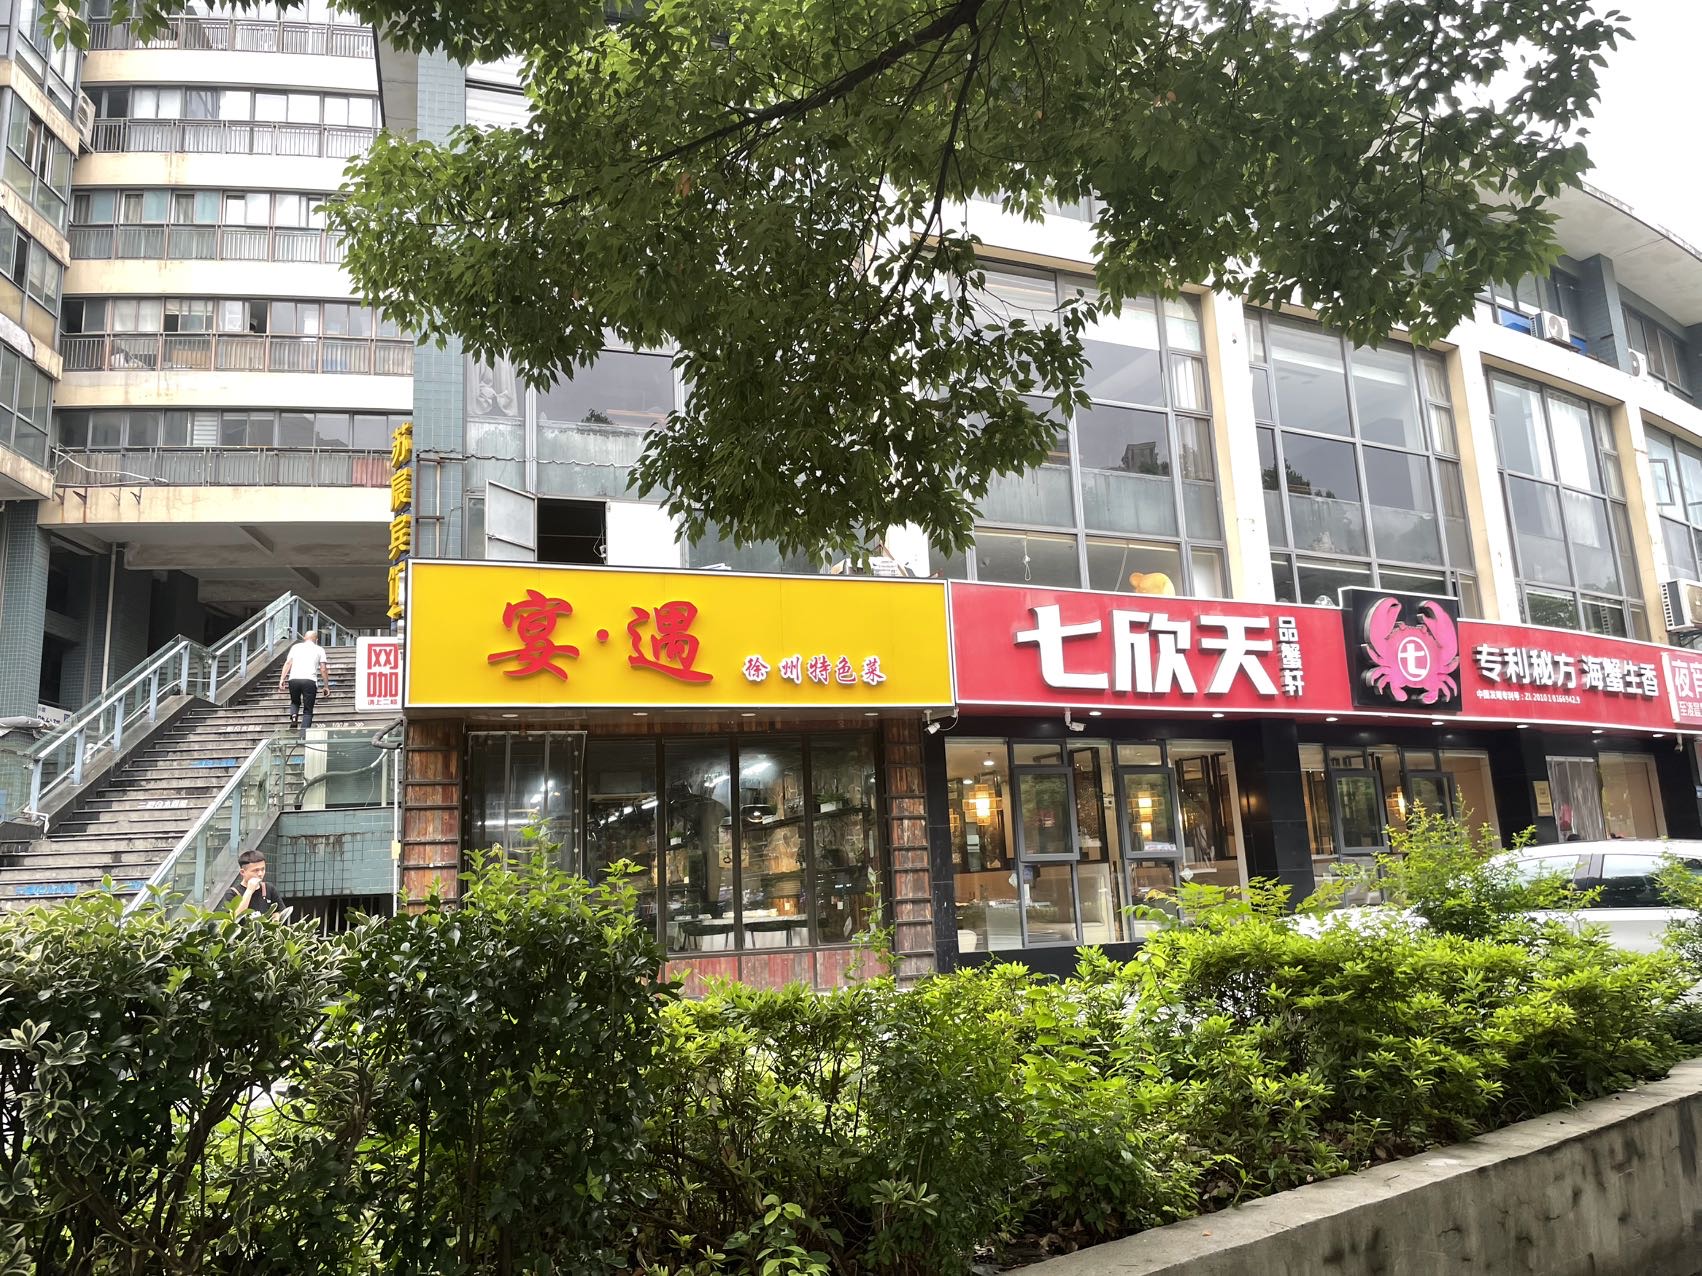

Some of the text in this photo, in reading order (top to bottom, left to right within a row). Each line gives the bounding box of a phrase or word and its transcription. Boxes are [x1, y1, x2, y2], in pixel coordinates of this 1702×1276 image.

[367, 643, 398, 698] 网咖
[742, 654, 887, 685] 徐州特色菜
[1015, 604, 1278, 695] 七欣天
[1278, 616, 1305, 696] 品蟹轩
[1401, 644, 1426, 676] 七
[1477, 643, 1660, 697] 专利秘方 海蟹生香
